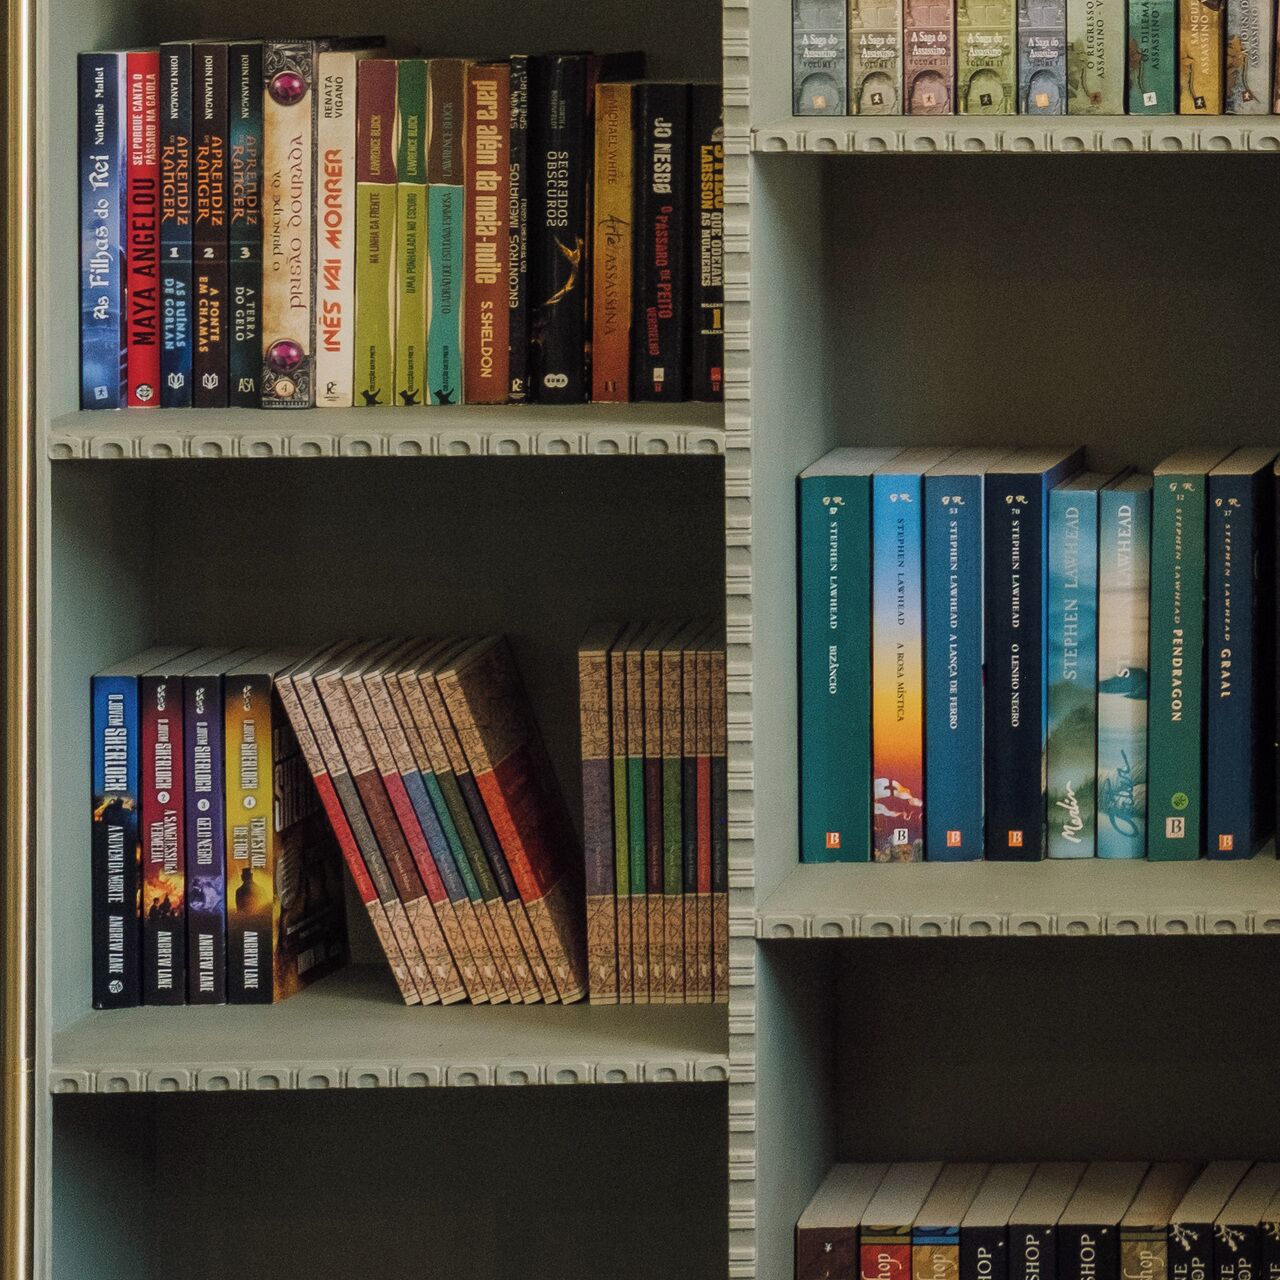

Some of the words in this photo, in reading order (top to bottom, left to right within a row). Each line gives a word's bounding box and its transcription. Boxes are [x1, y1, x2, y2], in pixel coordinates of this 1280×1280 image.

[323, 149, 342, 250] MORRER
[133, 178, 156, 277] ANGELOU
[323, 259, 342, 293] VAI
[132, 290, 156, 346] MAYA
[319, 300, 341, 353] INÊS
[830, 522, 838, 571] STEPHEN
[830, 574, 838, 630] LAWHEAD
[829, 645, 838, 696] BIZÂNCIO
[104, 727, 126, 792] SHERLOCK
[109, 916, 123, 951] ANDREW
[109, 954, 123, 974] LANE
